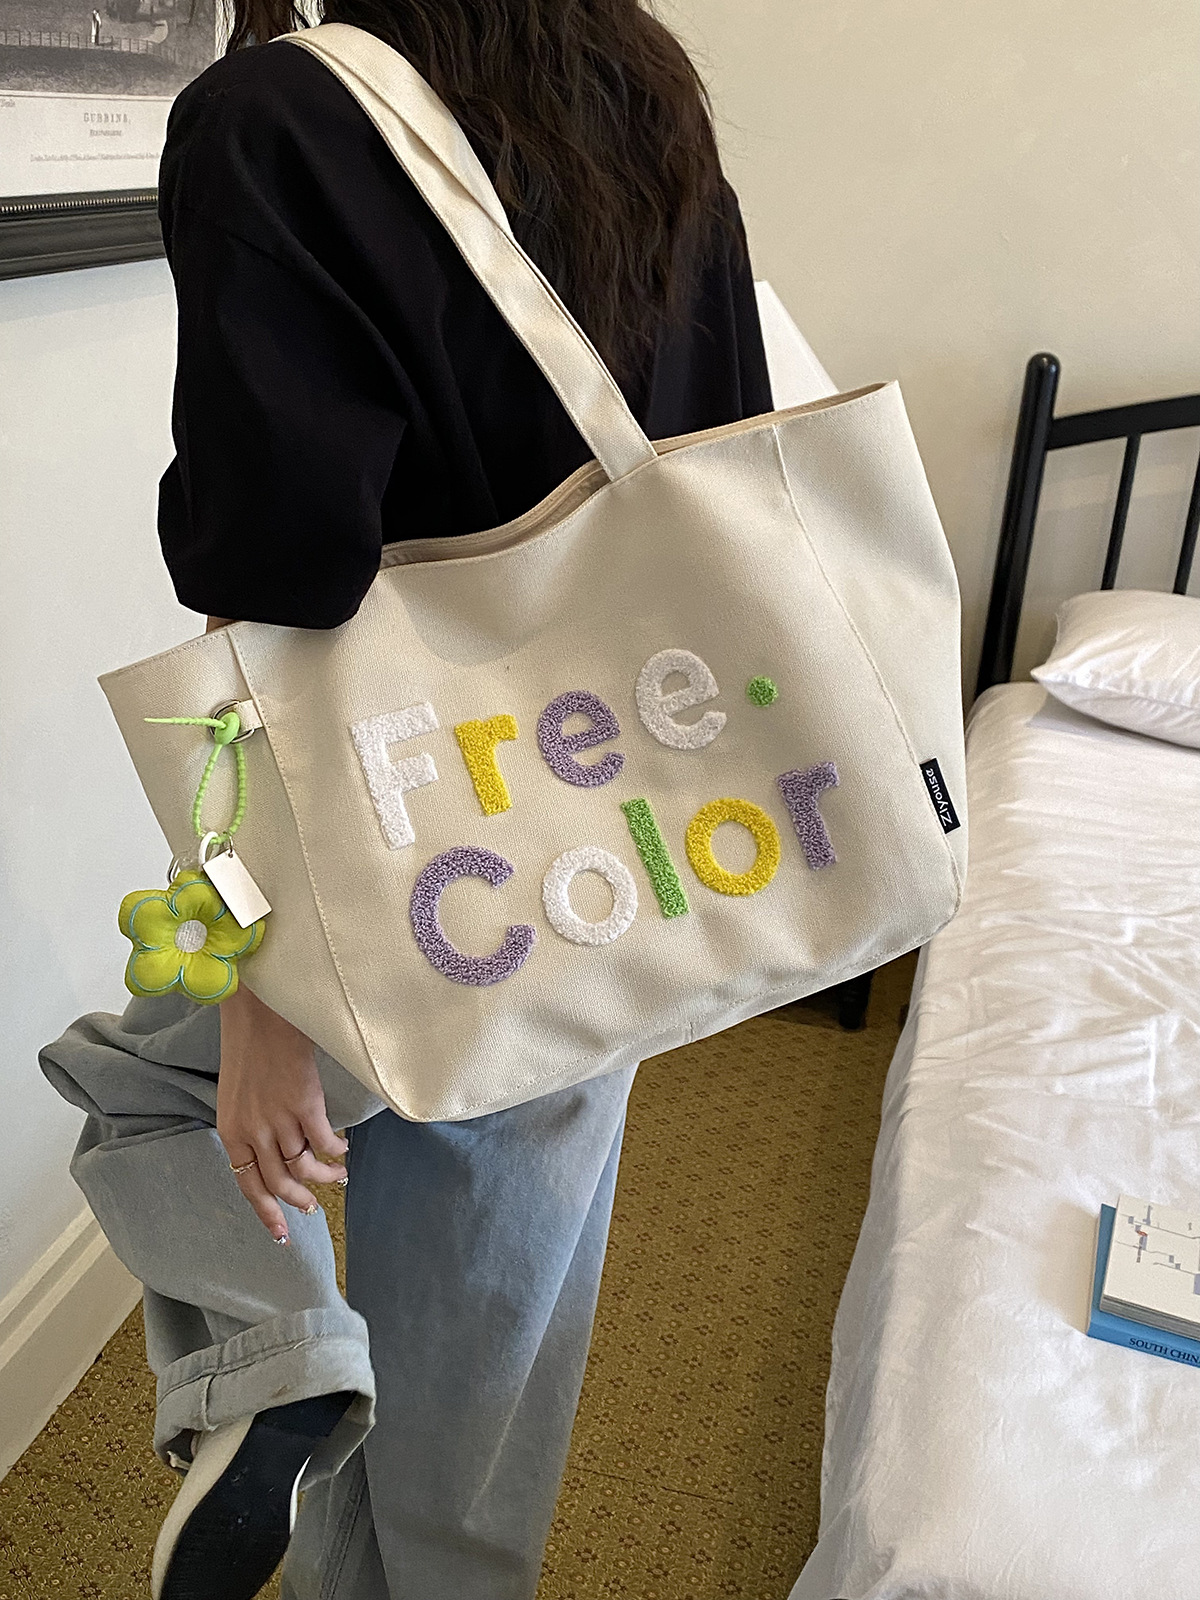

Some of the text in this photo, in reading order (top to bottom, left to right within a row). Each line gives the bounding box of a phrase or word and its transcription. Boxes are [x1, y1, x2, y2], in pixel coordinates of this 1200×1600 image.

[925, 768, 953, 827] Ziyouse
[410, 760, 840, 987] Color
[1129, 1337, 1200, 1364] SOUTH CHIN
